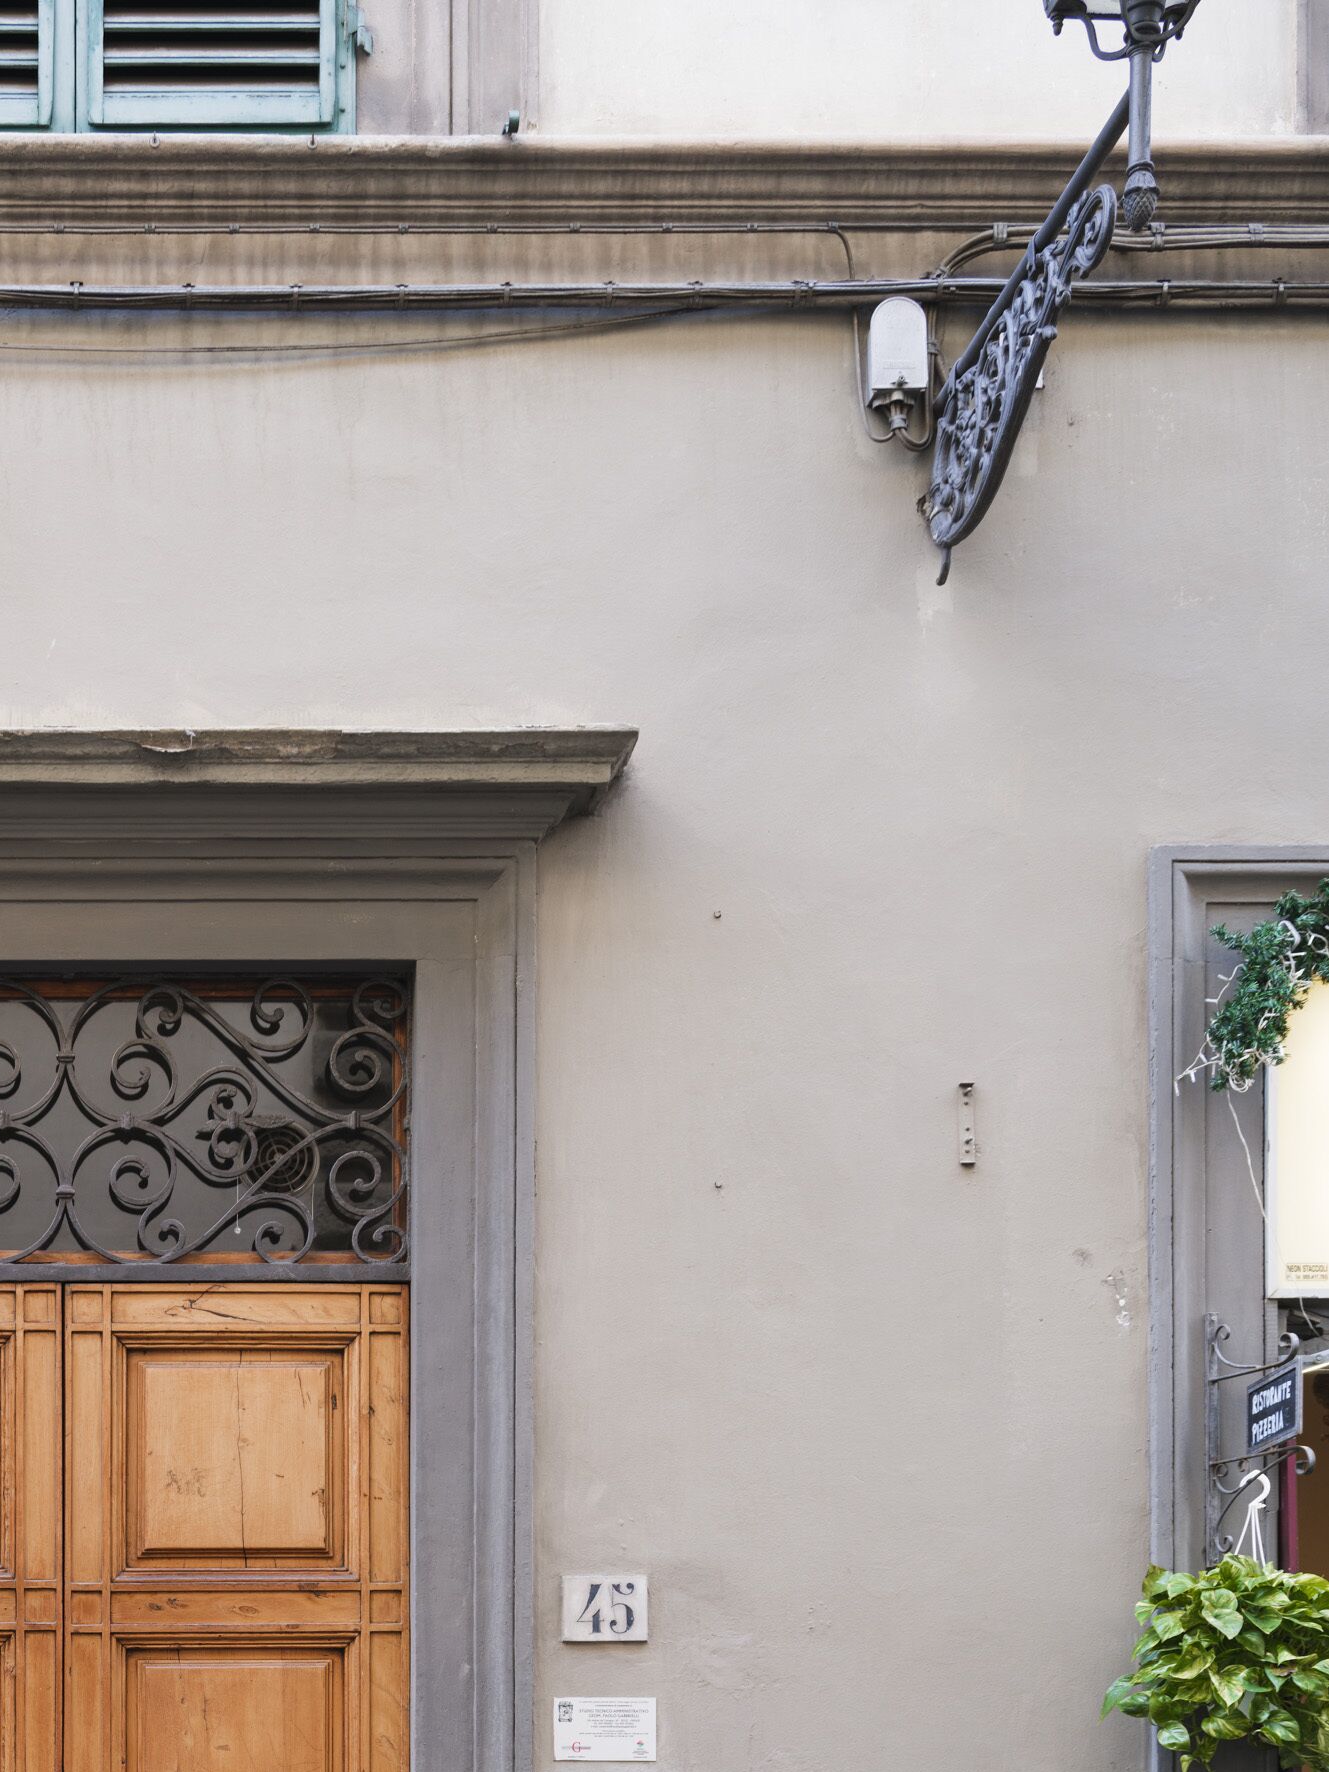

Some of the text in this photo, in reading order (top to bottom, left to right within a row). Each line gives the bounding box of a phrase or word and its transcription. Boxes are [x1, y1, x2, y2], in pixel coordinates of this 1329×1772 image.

[1252, 1380, 1292, 1415] RISTORANTE
[1252, 1409, 1284, 1446] PIZZERIA
[576, 1582, 635, 1634] 45
